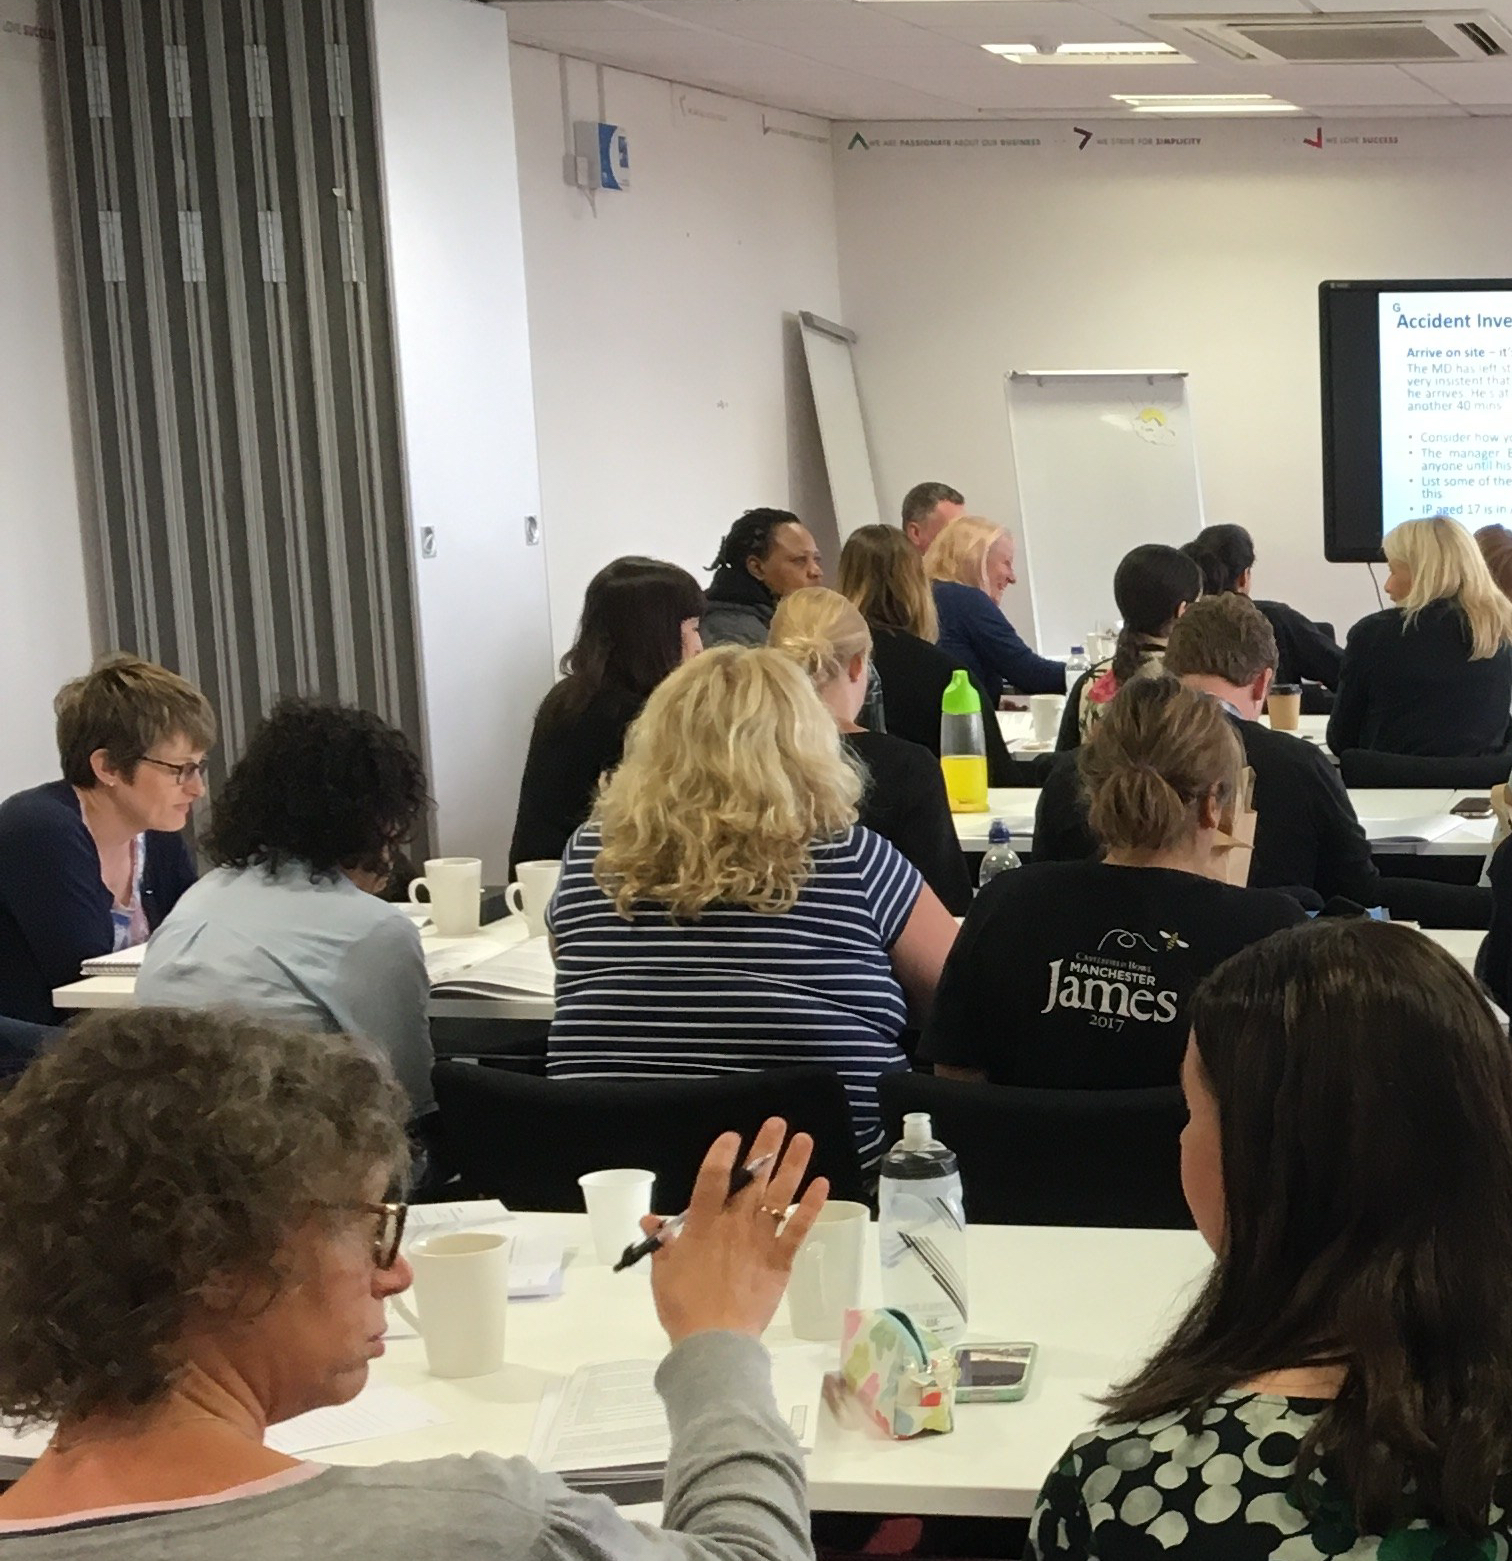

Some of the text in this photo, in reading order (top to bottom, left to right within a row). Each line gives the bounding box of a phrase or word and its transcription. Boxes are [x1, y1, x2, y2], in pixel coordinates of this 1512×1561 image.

[900, 139, 951, 147] PASSIONATE
[1397, 313, 1471, 329] Accident
[1407, 347, 1442, 358] Arrive
[1446, 350, 1461, 358] on
[1465, 347, 1485, 358] site
[1407, 363, 1428, 373] The
[1431, 363, 1452, 373] MD
[1456, 363, 1475, 373] has
[1407, 377, 1431, 387] very
[1435, 375, 1483, 386] insistent
[1487, 375, 1510, 386] that
[1407, 388, 1421, 399] he
[1498, 389, 1509, 398] at
[1407, 400, 1453, 412] another
[1456, 400, 1471, 411] 40
[1420, 432, 1471, 444] Consider
[1474, 432, 1499, 443] how
[1421, 448, 1442, 459] The
[1421, 462, 1463, 472] anyone
[1466, 460, 1493, 471] until
[1496, 461, 1512, 471] his
[1421, 476, 1440, 487] List
[1444, 478, 1475, 487] some
[1478, 476, 1490, 487] of
[1493, 476, 1512, 487] the
[1422, 505, 1433, 514] IP
[1436, 504, 1463, 517] aged
[1467, 504, 1481, 514] 17
[1484, 504, 1493, 514] is
[1496, 504, 1507, 514] in
[1069, 962, 1156, 986] MANCHESTER
[1040, 958, 1178, 1023] James
[1088, 1014, 1125, 1033] 2017
